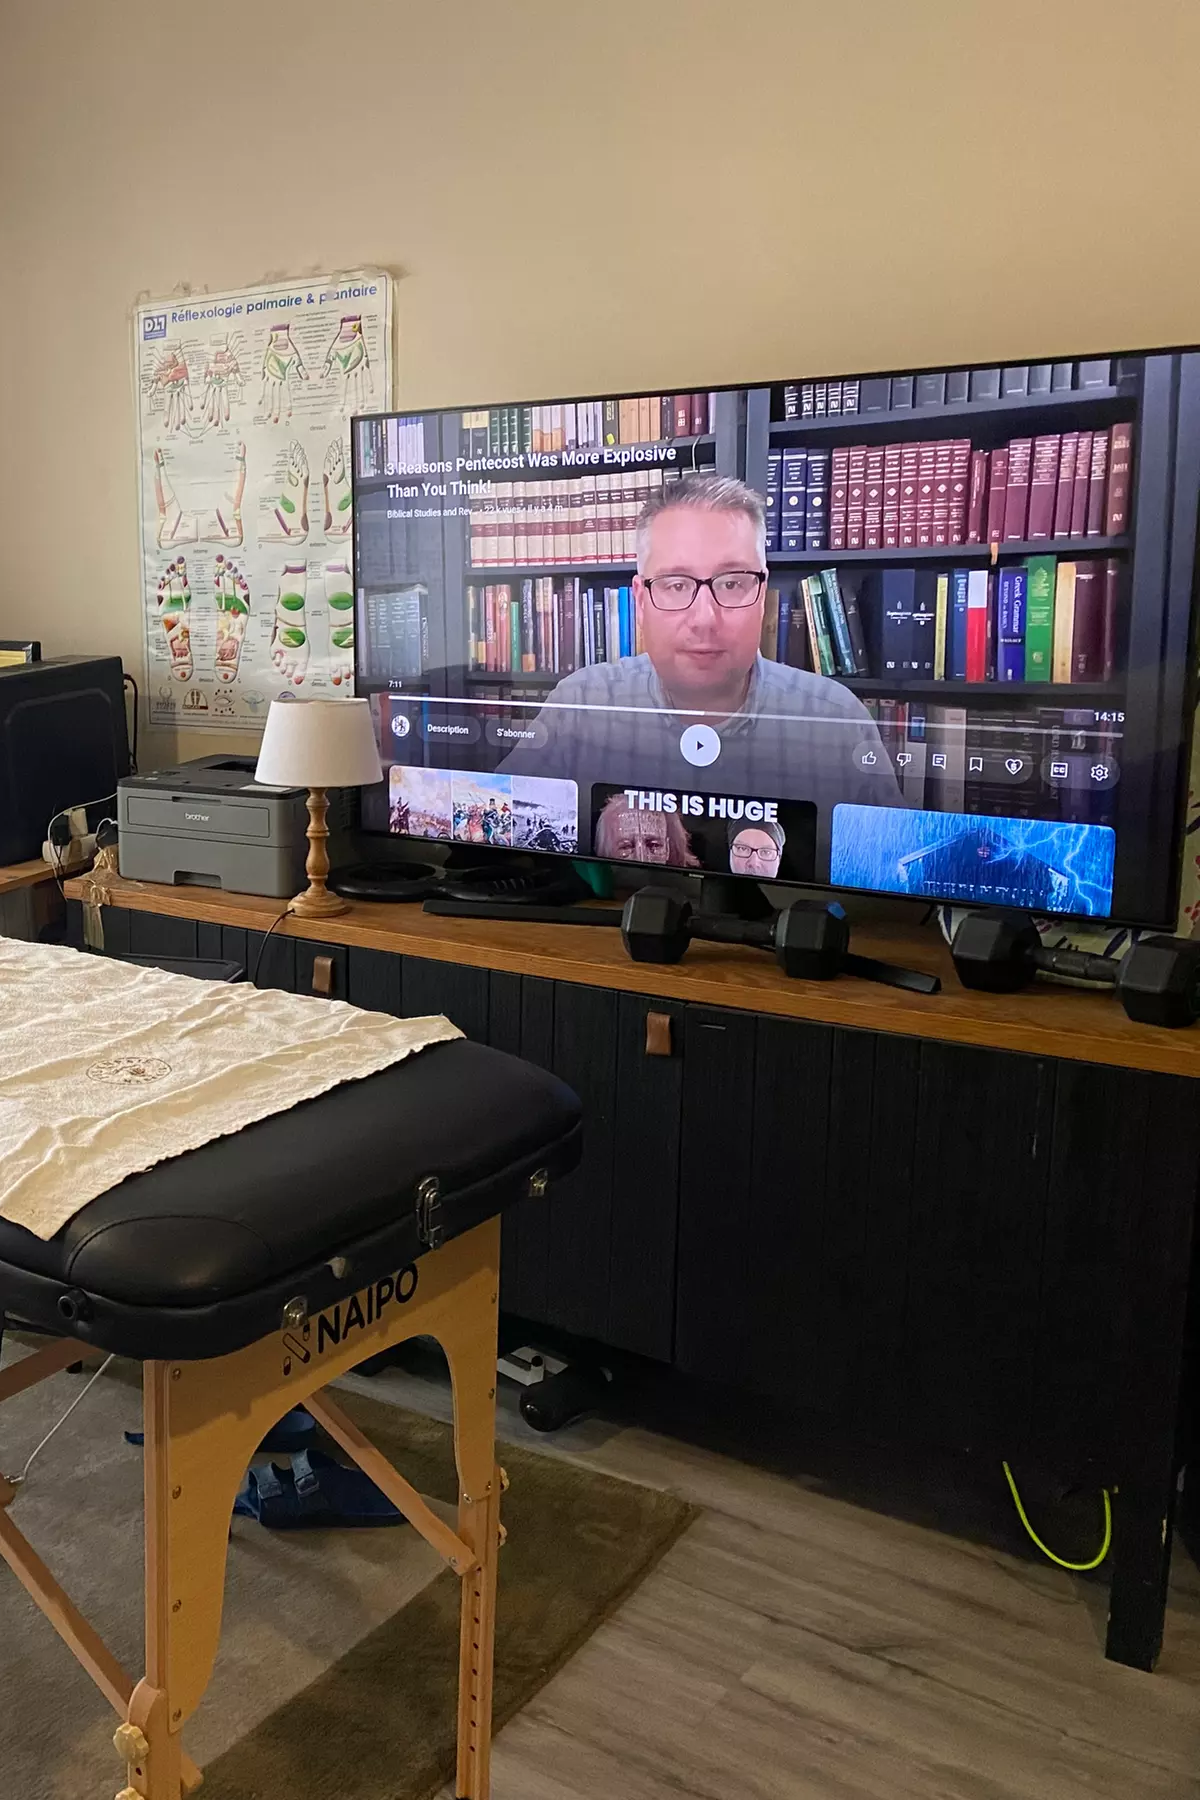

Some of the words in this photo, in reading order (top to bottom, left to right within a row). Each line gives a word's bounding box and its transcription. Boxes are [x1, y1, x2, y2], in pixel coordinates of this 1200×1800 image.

[172, 303, 243, 323] Réflexologie
[246, 295, 302, 314] palmaire
[306, 293, 315, 304] &
[319, 285, 377, 305] pantaire
[387, 463, 394, 475] 3
[398, 460, 453, 475] Reasons
[456, 454, 524, 472] Pentecost
[528, 453, 558, 468] Was
[562, 450, 599, 466] More
[604, 445, 676, 466] Explosive
[387, 484, 418, 498] Than
[421, 482, 446, 497] You
[450, 479, 491, 496] Think!
[387, 509, 412, 519] Biblical
[414, 508, 441, 518] Studies
[443, 507, 457, 517] and
[1094, 712, 1125, 722] 14:15
[427, 724, 469, 735] Description
[497, 728, 535, 739] S'abonner
[624, 789, 677, 814] THIS
[682, 795, 704, 816] IS
[709, 797, 778, 823] HUGE
[185, 812, 210, 821] brother
[318, 1262, 419, 1354] NAIPO
